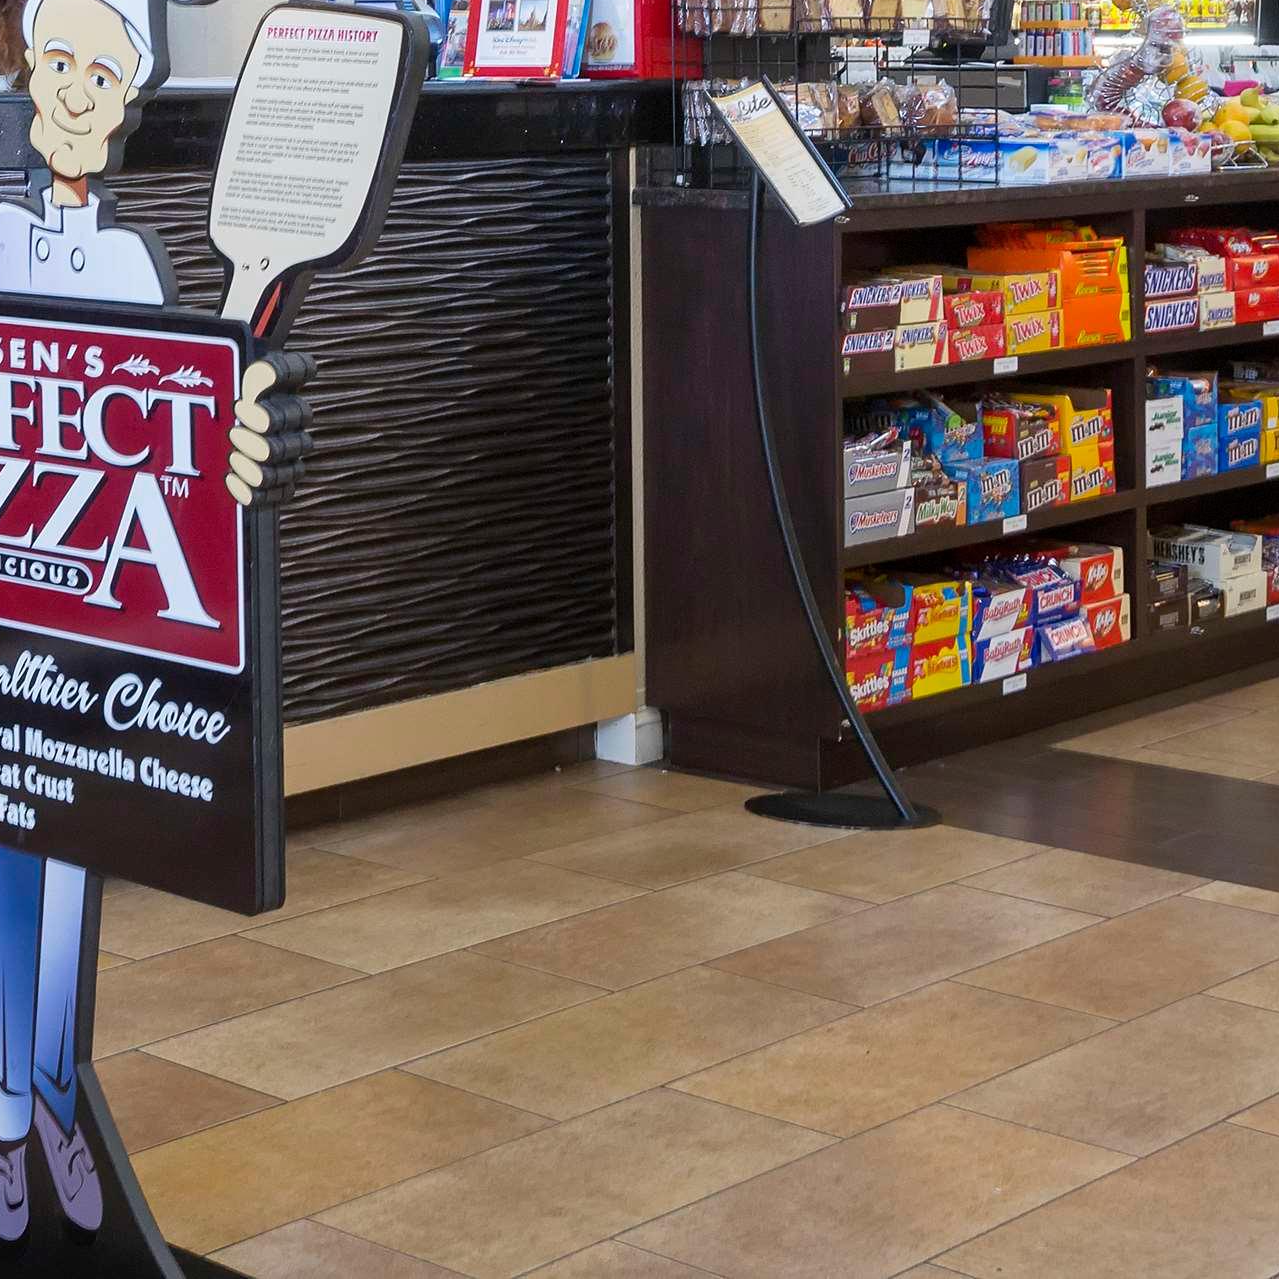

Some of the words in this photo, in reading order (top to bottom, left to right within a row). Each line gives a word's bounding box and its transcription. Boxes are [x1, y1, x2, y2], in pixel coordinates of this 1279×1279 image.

[266, 26, 306, 40] PERFECT
[306, 28, 336, 42] PIZZA
[336, 29, 380, 43] HISTORY
[1010, 277, 1043, 303] Twix
[1145, 266, 1195, 296] SNICKERS
[851, 286, 892, 305] SNICKERS
[953, 303, 986, 326] Twix
[1146, 300, 1197, 330] SNICKERS
[901, 326, 933, 344] SNICKERS
[1013, 315, 1045, 342] Twix
[844, 333, 884, 352] SNICKERS
[956, 336, 988, 359] Twix
[857, 462, 897, 479] Musketeers
[858, 510, 898, 528] Musketeers
[1152, 542, 1207, 566] HERSHEY'S
[1039, 586, 1074, 609] CRUNCH
[849, 620, 890, 647] Skittles
[849, 676, 890, 701] Skittles
[102, 672, 233, 746] Choice
[24, 726, 136, 783] Mozzarella
[139, 755, 215, 803] Cheese
[24, 764, 76, 805] Crust
